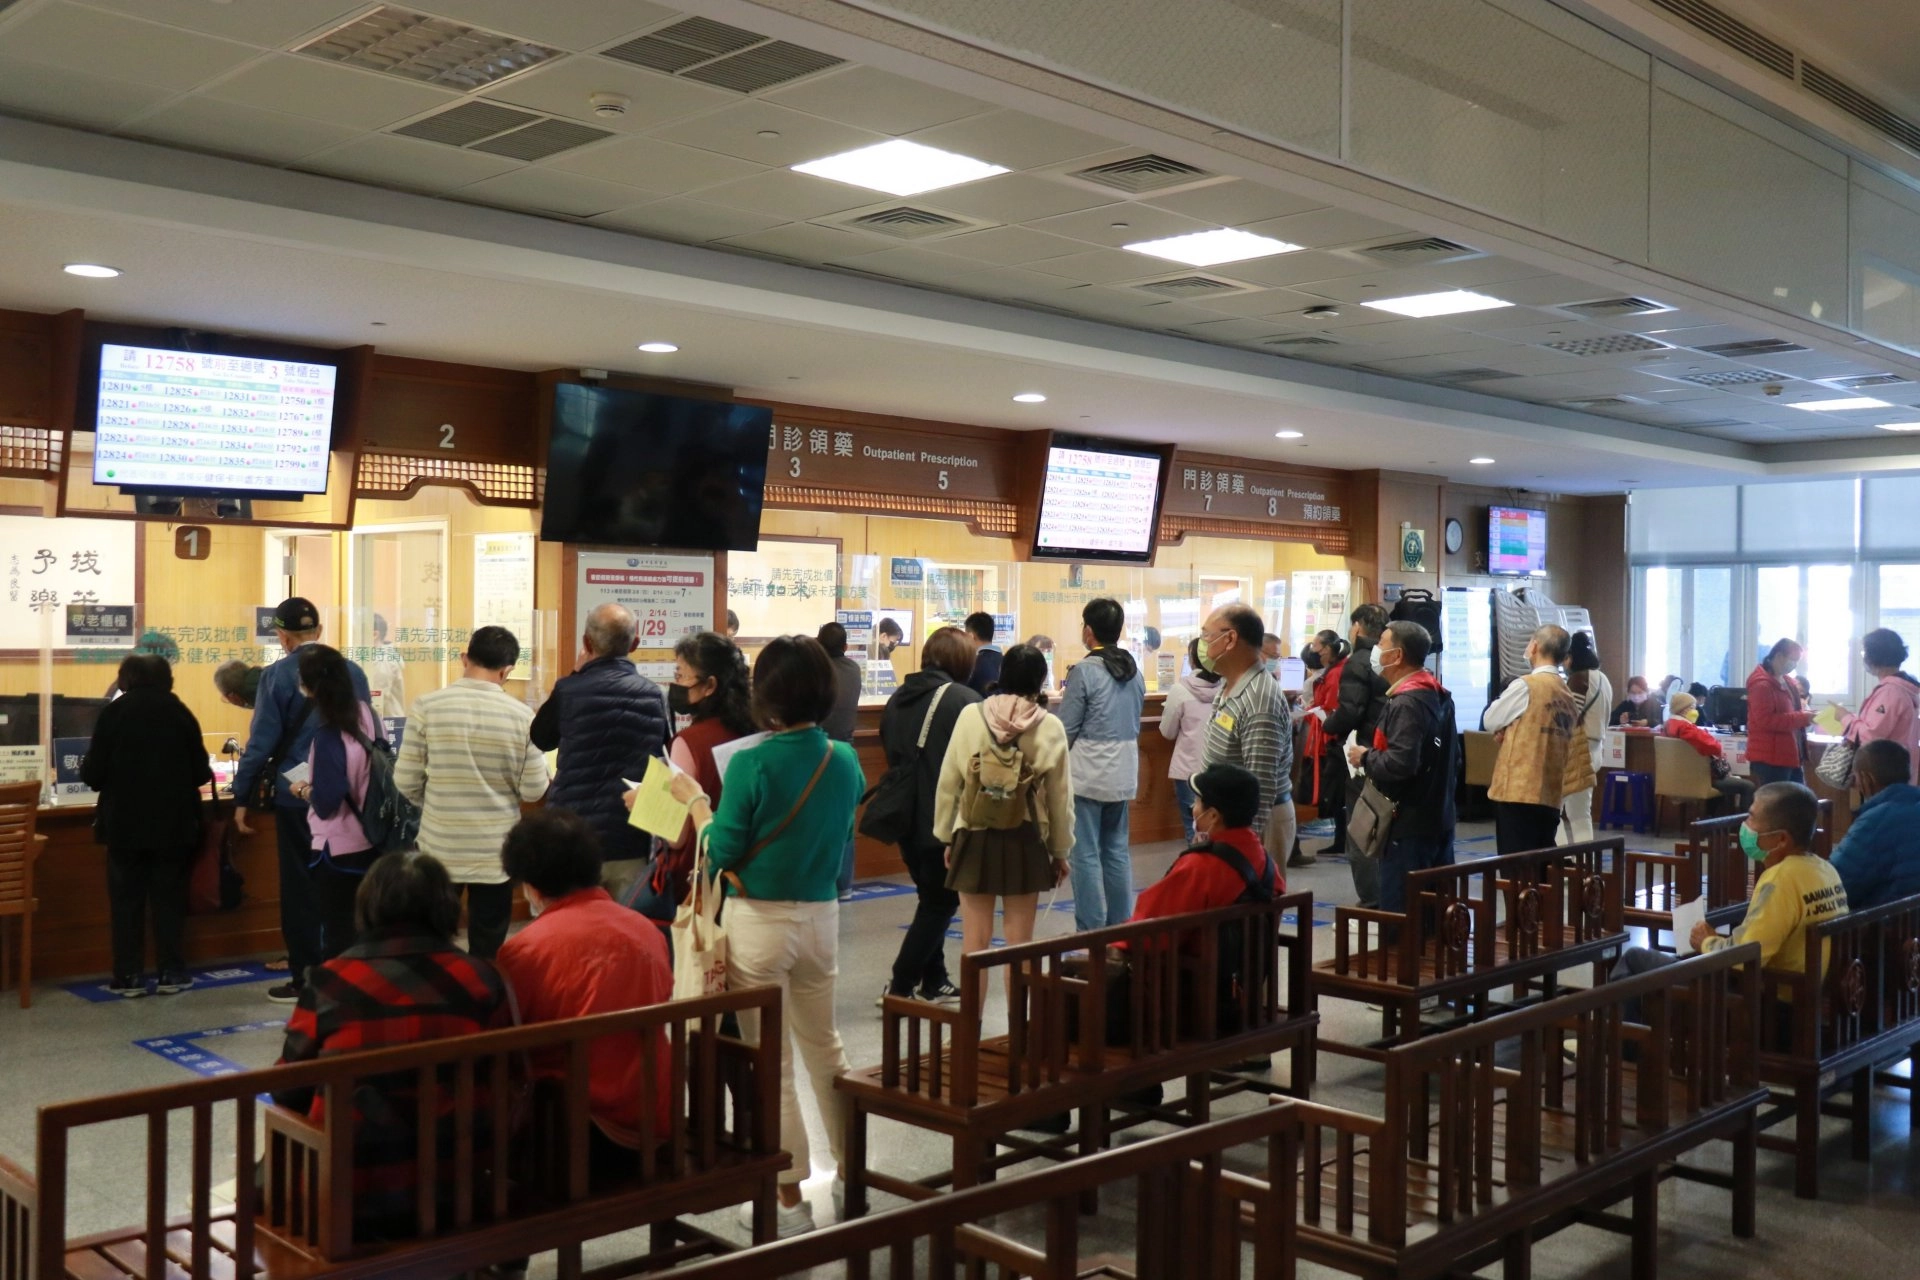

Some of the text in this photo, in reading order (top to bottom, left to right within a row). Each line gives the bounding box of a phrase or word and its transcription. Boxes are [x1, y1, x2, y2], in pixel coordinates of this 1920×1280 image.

[144, 354, 196, 374] 12758
[269, 365, 279, 381] 3
[439, 423, 455, 449] 2
[863, 445, 978, 469] Outpatient Prescription
[790, 457, 802, 478] 3
[938, 471, 949, 490] 5
[1183, 468, 1245, 495] 門診領藥
[1204, 494, 1213, 512] 7
[1250, 485, 1325, 502] Outpatient Prescription
[1268, 497, 1277, 517] 8
[1303, 504, 1341, 522] 預約領藥
[184, 531, 199, 557] 1
[771, 567, 833, 582] 請先完成批價
[72, 613, 129, 627] 敬老櫃檯
[649, 609, 667, 617] 2/14
[395, 627, 475, 643] 請先完成批
